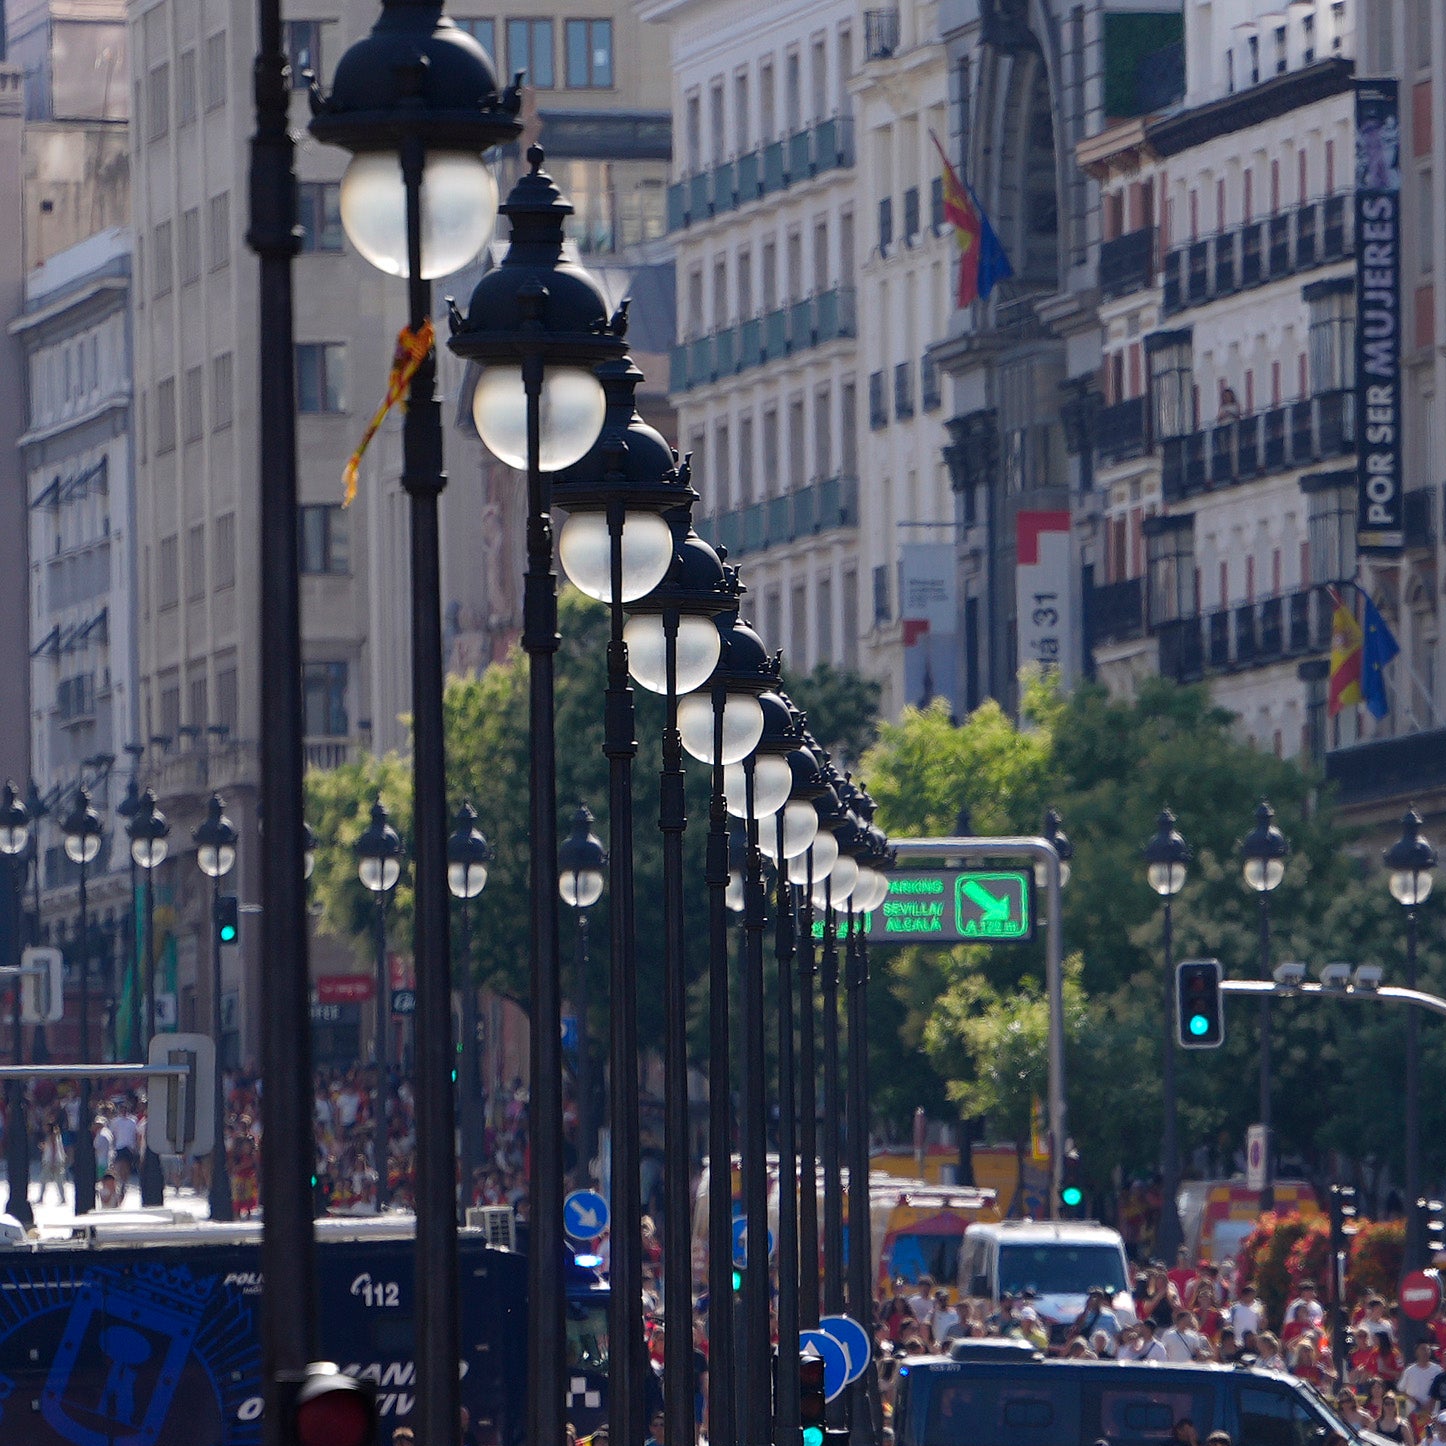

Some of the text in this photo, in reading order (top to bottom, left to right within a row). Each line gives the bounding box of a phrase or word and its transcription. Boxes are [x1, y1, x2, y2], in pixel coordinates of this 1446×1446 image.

[1363, 196, 1395, 525] POR SER MUJERES
[1032, 592, 1058, 626] 31
[362, 1282, 399, 1307] 112
